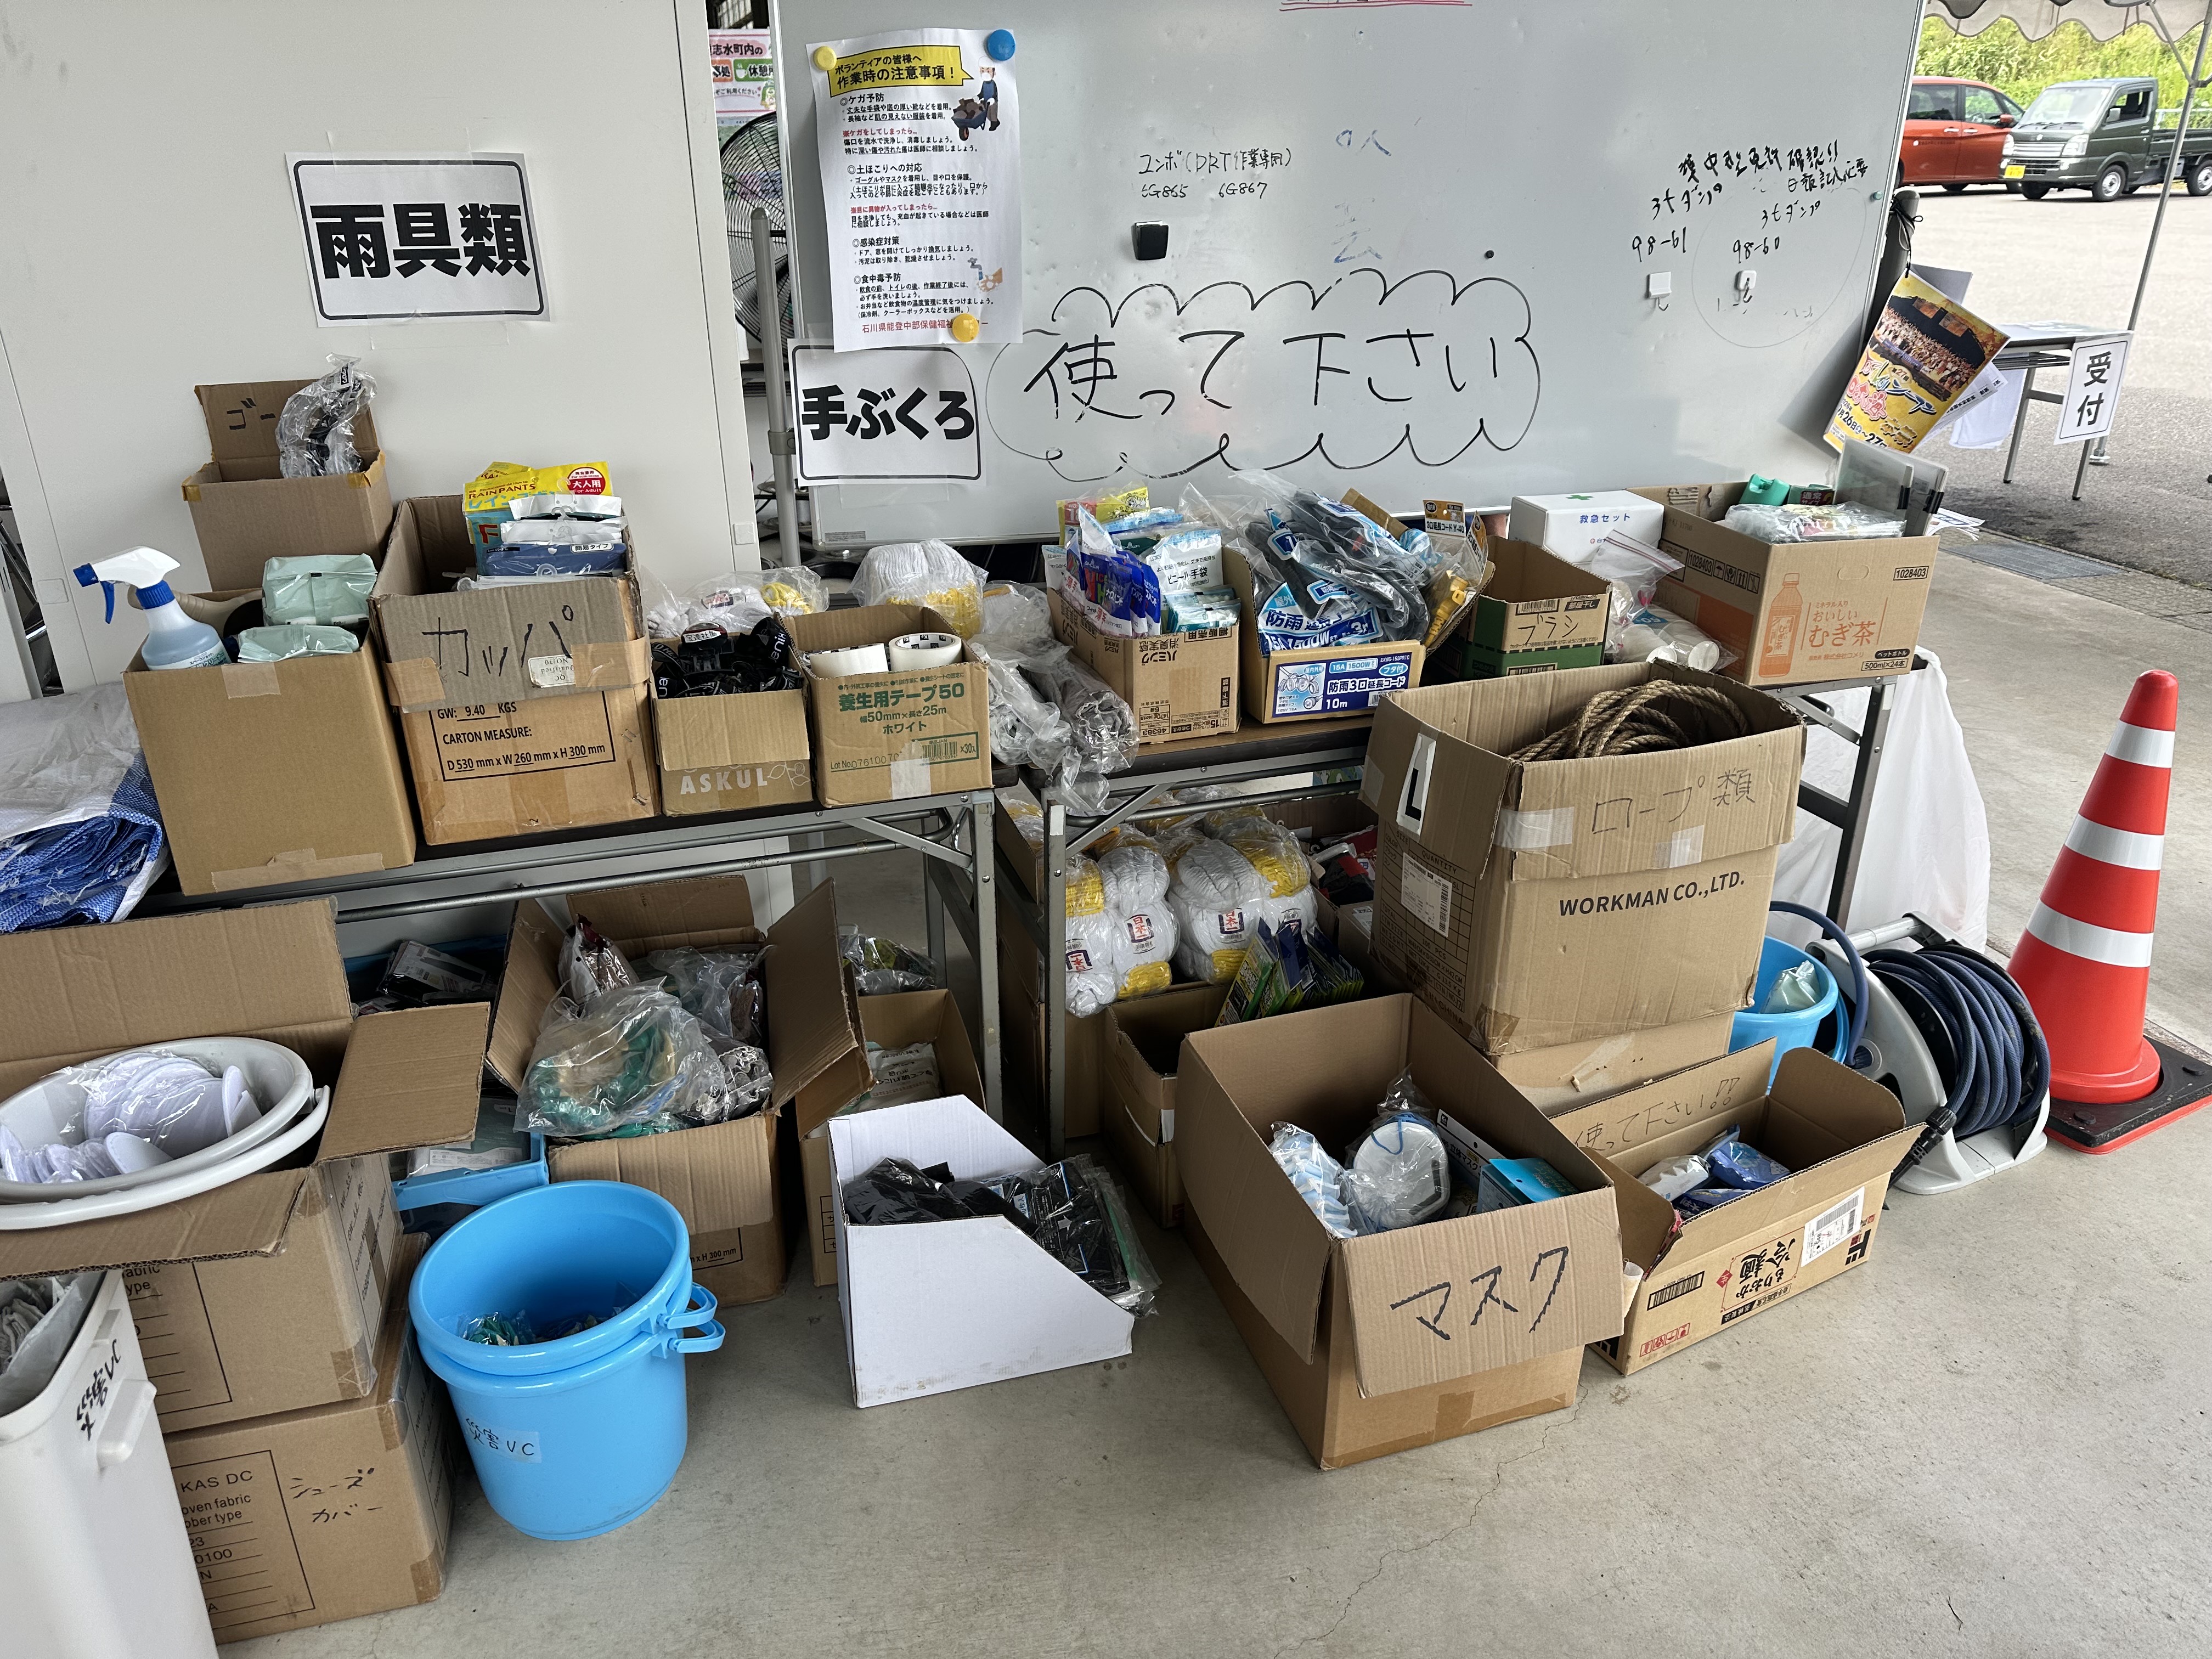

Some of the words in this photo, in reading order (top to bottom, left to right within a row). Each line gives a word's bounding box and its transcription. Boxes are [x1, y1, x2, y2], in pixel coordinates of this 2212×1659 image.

[709, 43, 763, 56] 志水町内の
[835, 53, 922, 75] ボランティアの皆様へ
[837, 65, 953, 89] 作業時の注意事項！
[1219, 182, 1267, 199] 6G867
[309, 203, 531, 279] 雨具類
[1024, 325, 1501, 424] 使って下さい
[2076, 350, 2112, 427] 受付
[802, 385, 975, 442] 手ぶくろ
[572, 480, 601, 488] 大人用
[1579, 513, 1630, 524] 救急セット
[1168, 567, 1208, 584] ビニール手袋
[1896, 568, 1926, 578] 1028403
[1568, 600, 1595, 610] 部屋干し
[1266, 609, 1304, 630] 防雨
[1813, 609, 1858, 622] おいしい
[1517, 613, 1579, 645] ブラシ
[1809, 620, 1876, 648] むぎ茶
[421, 605, 574, 677] カッパ
[1139, 638, 1179, 652] 消臭実感
[1142, 650, 1177, 664] ハミング
[1384, 666, 1403, 674] フタ付
[1328, 676, 1406, 693] 防雨3口延長コード
[838, 682, 964, 712] 養生用テープ50
[1326, 698, 1348, 709] 10m
[437, 708, 458, 720] GW:
[465, 705, 486, 717] 9.40
[498, 702, 517, 714] KGS
[443, 731, 483, 745] CARTON
[484, 726, 533, 741] MEASURE:
[883, 721, 927, 735] ホワイト
[447, 760, 455, 771] D
[456, 758, 474, 770] 530
[476, 758, 494, 768] mm
[496, 757, 502, 765] x
[502, 754, 512, 765] W
[514, 752, 532, 764] 260
[533, 751, 551, 761] mm
[553, 751, 559, 759] x
[560, 747, 567, 758] H
[568, 745, 586, 757] 300
[588, 744, 606, 754] mm
[831, 761, 840, 769] Lot
[680, 772, 768, 795] ASKUL
[1592, 768, 1756, 835] ロープ類
[1396, 831, 1408, 845] SIZE
[1421, 850, 1457, 874] QUANTITY
[1559, 888, 1669, 916] WORKMAN
[1673, 871, 1745, 901] CO.,LTD.
[1133, 916, 1146, 939] 日本一
[709, 1250, 723, 1259] 300
[724, 1248, 736, 1256] mm
[1739, 1238, 1796, 1284] 冷麺
[1391, 1246, 1568, 1340] マスク
[1736, 1268, 1784, 1299] もりおか
[225, 1470, 253, 1484] DC
[289, 1467, 376, 1499] シューズ
[215, 1494, 251, 1509] fabric
[215, 1509, 242, 1527] type
[312, 1504, 383, 1523] カバー
